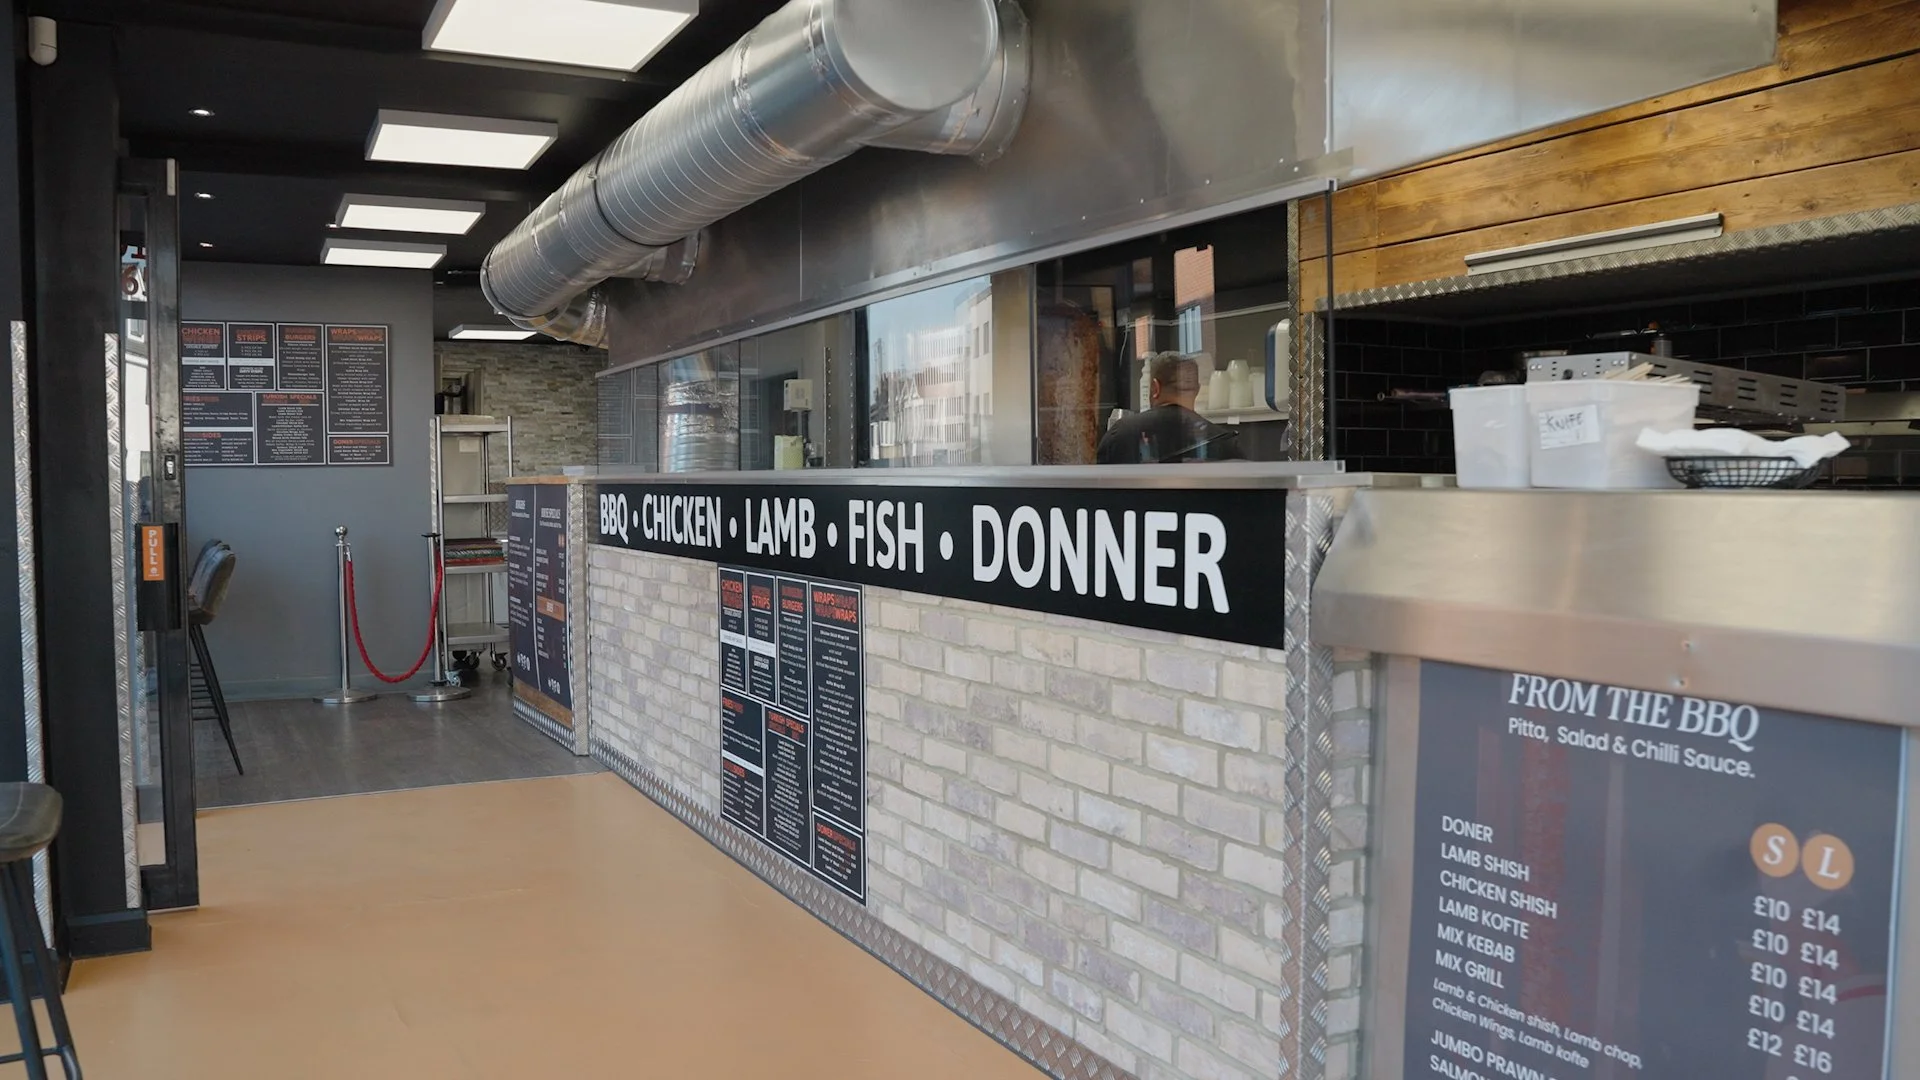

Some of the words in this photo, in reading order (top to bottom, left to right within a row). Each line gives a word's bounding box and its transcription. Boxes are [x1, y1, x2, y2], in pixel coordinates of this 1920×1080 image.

[182, 327, 220, 335] CHICKEN
[236, 334, 266, 342] STRIPS
[148, 529, 158, 565] PULL
[600, 493, 629, 544] BBQ
[642, 493, 721, 548] CHICKEN
[745, 497, 817, 558] LAMB
[849, 500, 925, 573] FISH
[972, 504, 1230, 614] DONNER
[722, 579, 743, 593] CHICKEN
[751, 595, 770, 609] STRIPS
[782, 599, 803, 612] BURGERS
[1508, 672, 1600, 717] FROM
[1607, 685, 1674, 729] THE
[1677, 696, 1759, 752] BBQ
[1508, 717, 1550, 743] Pitta,
[1557, 726, 1610, 751] Salad
[1612, 736, 1627, 755] &
[1631, 739, 1680, 764] Chilli
[1683, 747, 1755, 778] Sauce.
[1442, 815, 1493, 843] DONER
[1441, 843, 1481, 868] LAMB
[1484, 854, 1530, 882] SHISH
[1763, 835, 1786, 865] S
[1817, 846, 1841, 879] L
[1440, 870, 1507, 904] CHICKEN
[1510, 890, 1558, 919] SHISH
[1753, 895, 1791, 922] £10
[1801, 907, 1842, 936] £14
[1439, 896, 1479, 923] LAMB
[1482, 909, 1530, 940] KOFTE
[1437, 923, 1464, 946] MIX
[1467, 933, 1516, 963] KEBAB
[1752, 928, 1789, 956] £10
[1800, 942, 1840, 970] £14
[1435, 950, 1462, 973] MIX
[1465, 961, 1504, 989] GRILL
[1750, 962, 1787, 989] £10
[1798, 976, 1838, 1005] £14
[1432, 997, 1477, 1024] Chicken
[1479, 1015, 1517, 1041] Wings,
[1519, 1031, 1555, 1054] Lamb
[1556, 1043, 1590, 1069] kofte
[1433, 978, 1466, 1000] Lamb
[1466, 990, 1476, 1003] &
[1478, 994, 1526, 1022] Chicken
[1527, 1015, 1562, 1039] shish,
[1564, 1028, 1601, 1051] Lamb
[1748, 995, 1785, 1022] £10
[1796, 1010, 1835, 1039] £14
[1431, 1030, 1484, 1063] JUMBO
[1486, 1051, 1545, 1080] PRAWN
[1747, 1028, 1782, 1057] £12
[1793, 1044, 1833, 1074] £16
